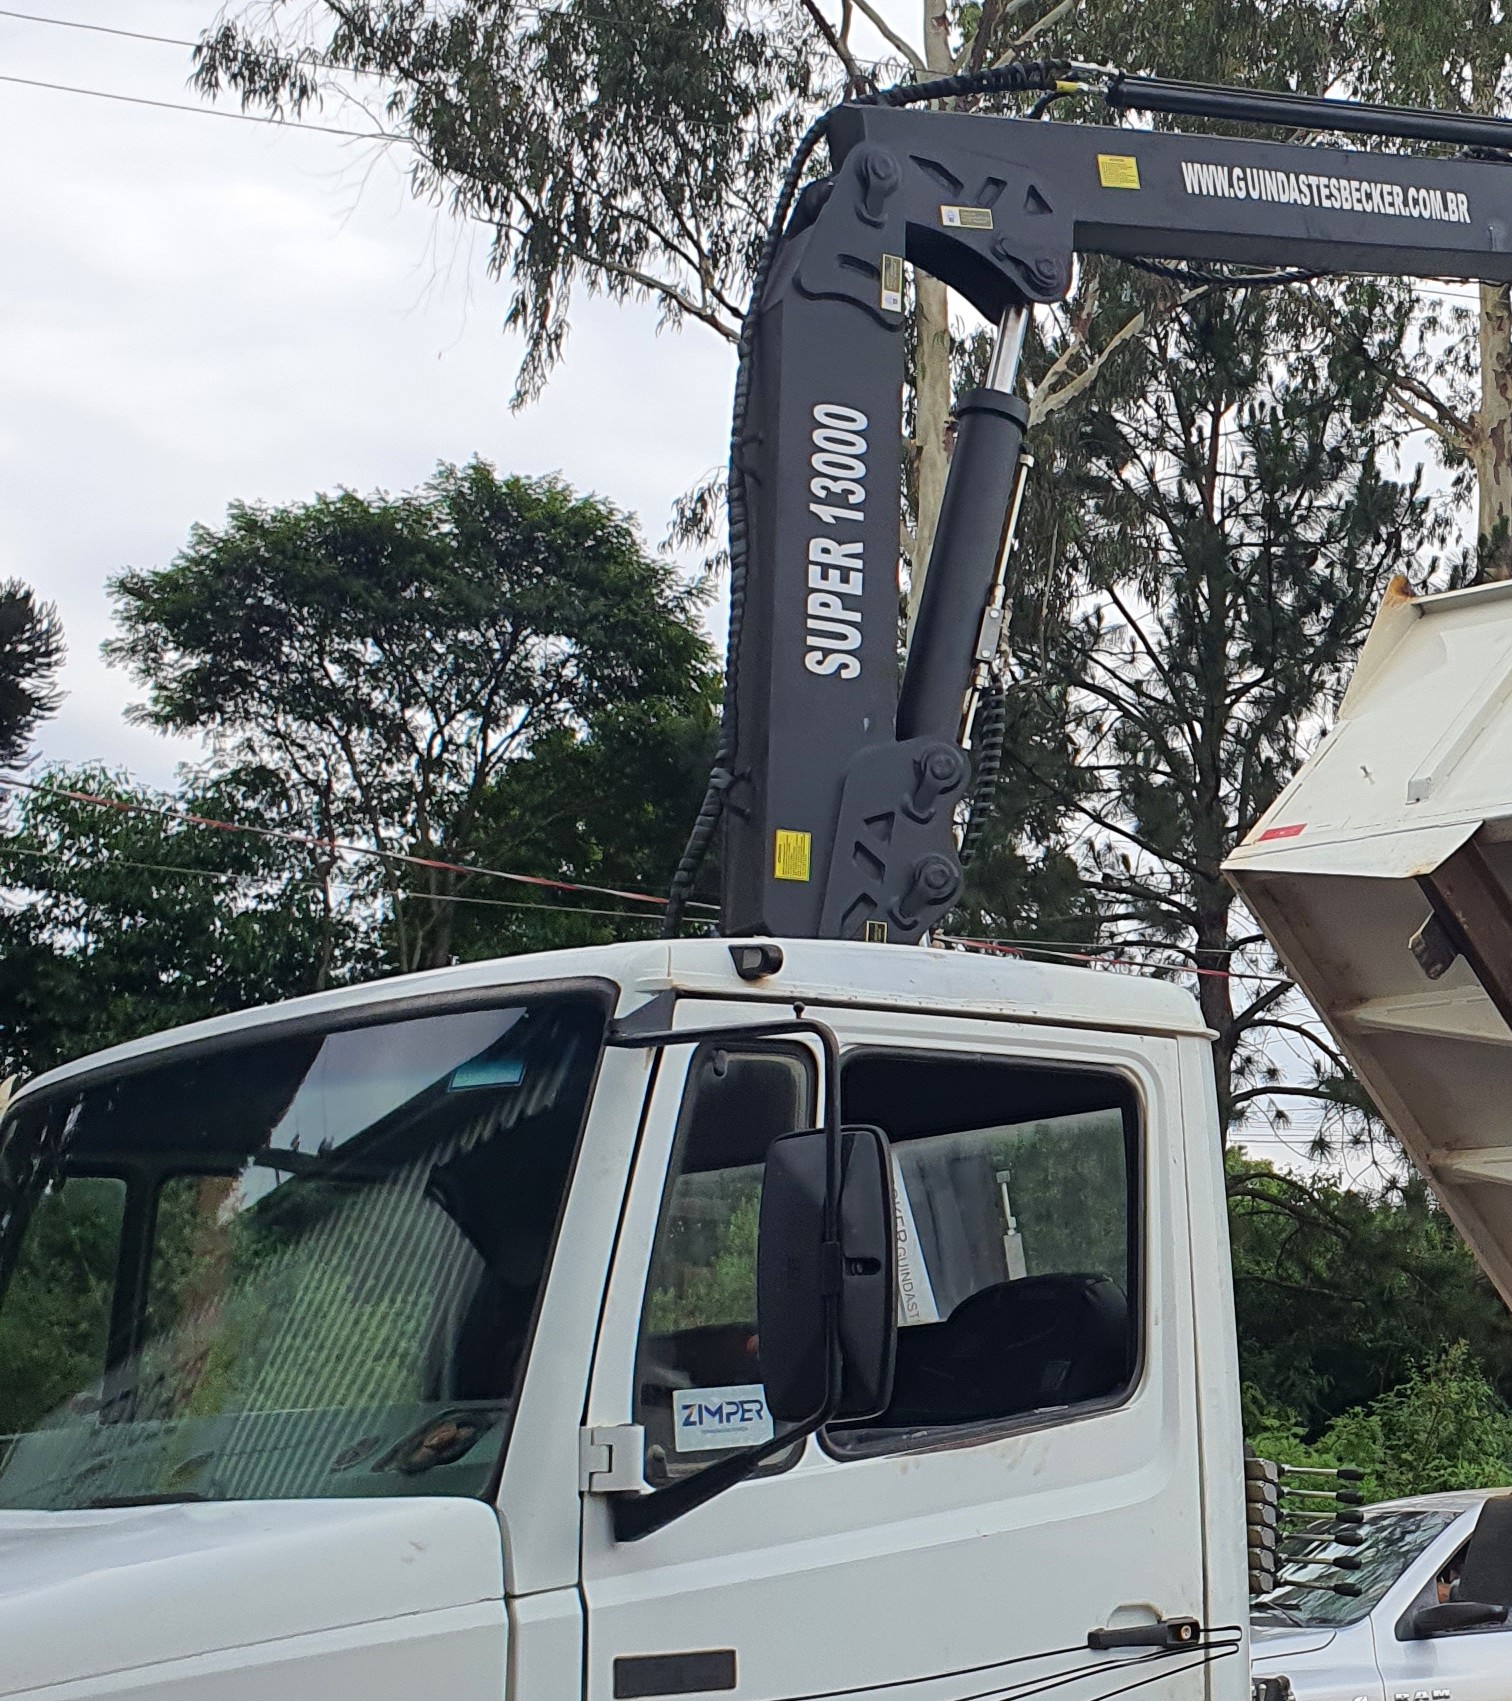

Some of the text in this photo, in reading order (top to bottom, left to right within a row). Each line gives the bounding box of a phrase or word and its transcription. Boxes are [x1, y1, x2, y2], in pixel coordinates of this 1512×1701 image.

[1181, 161, 1471, 224] WWW.GUINDASTESBECKER.COM.BR
[804, 403, 868, 680] SUPER 13000
[681, 1399, 764, 1428] ZIMPER
[1393, 1689, 1451, 1701] RAM
